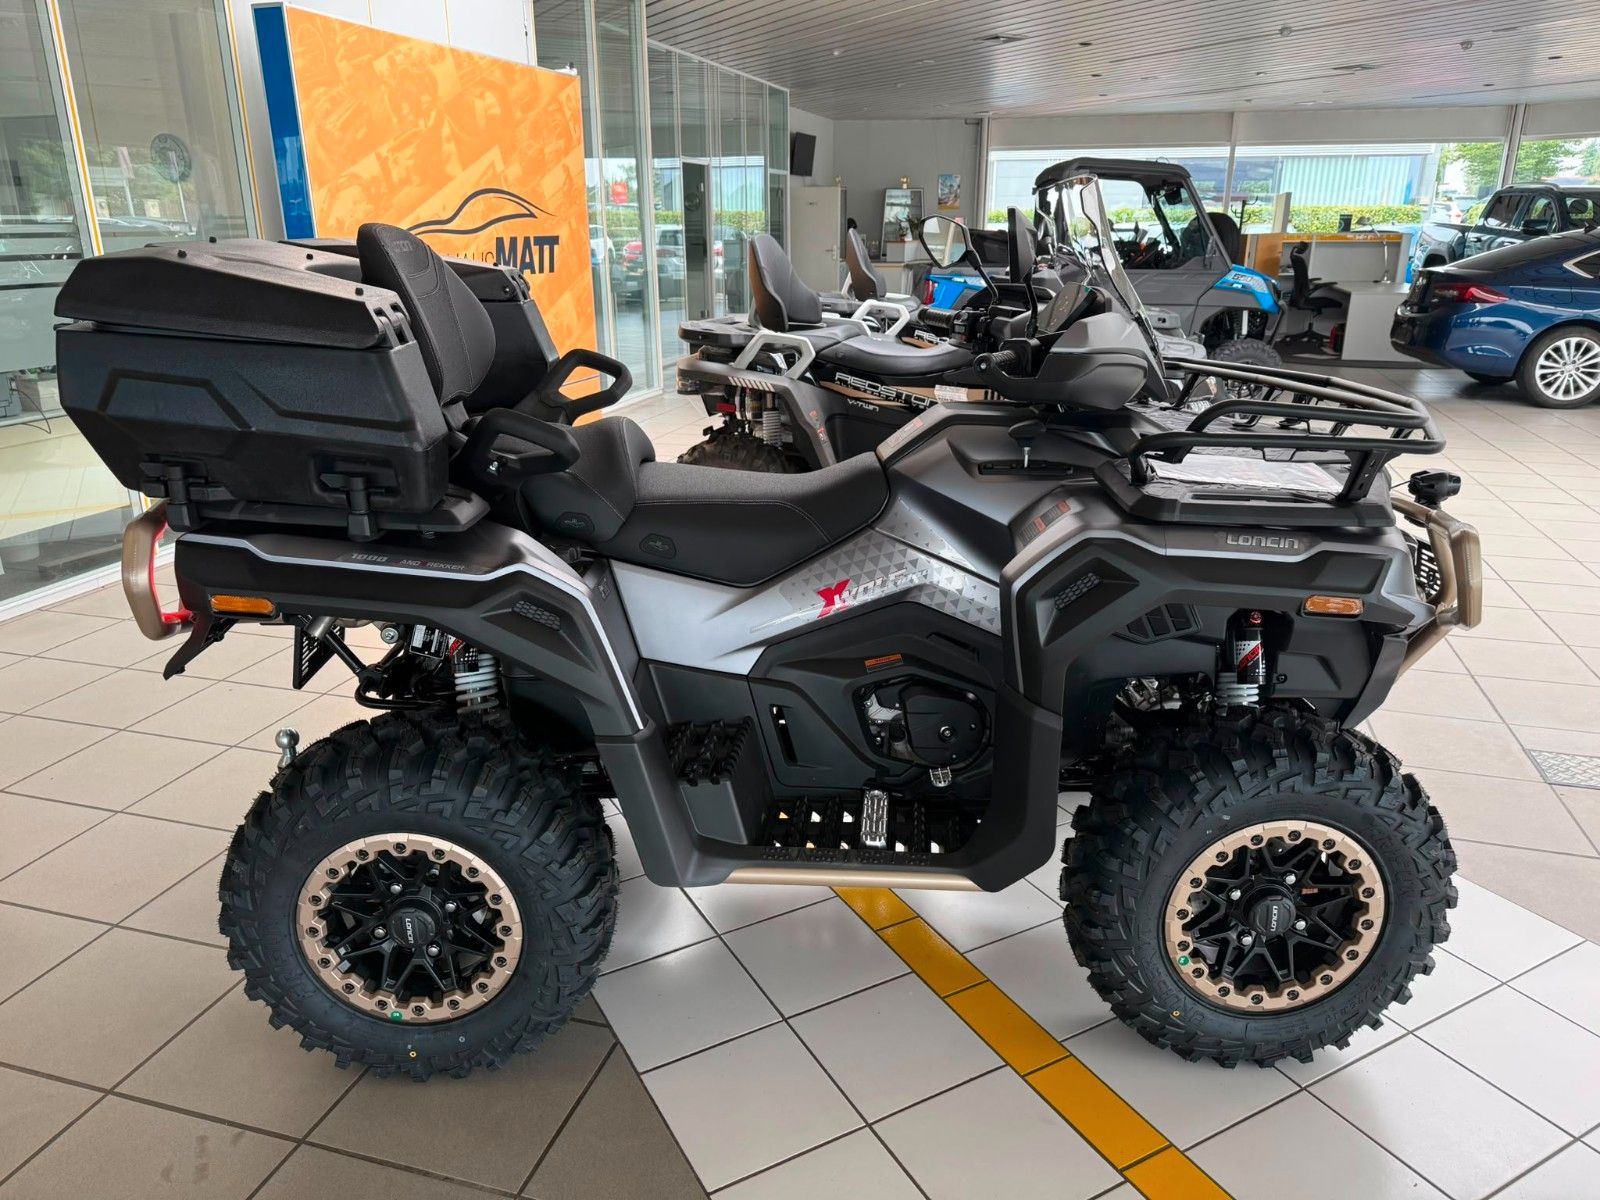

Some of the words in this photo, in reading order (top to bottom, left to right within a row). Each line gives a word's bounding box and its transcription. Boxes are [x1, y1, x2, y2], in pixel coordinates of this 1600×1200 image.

[496, 235, 560, 275] MATT
[835, 372, 938, 405] REDSTOR
[1227, 534, 1299, 549] LONCIN
